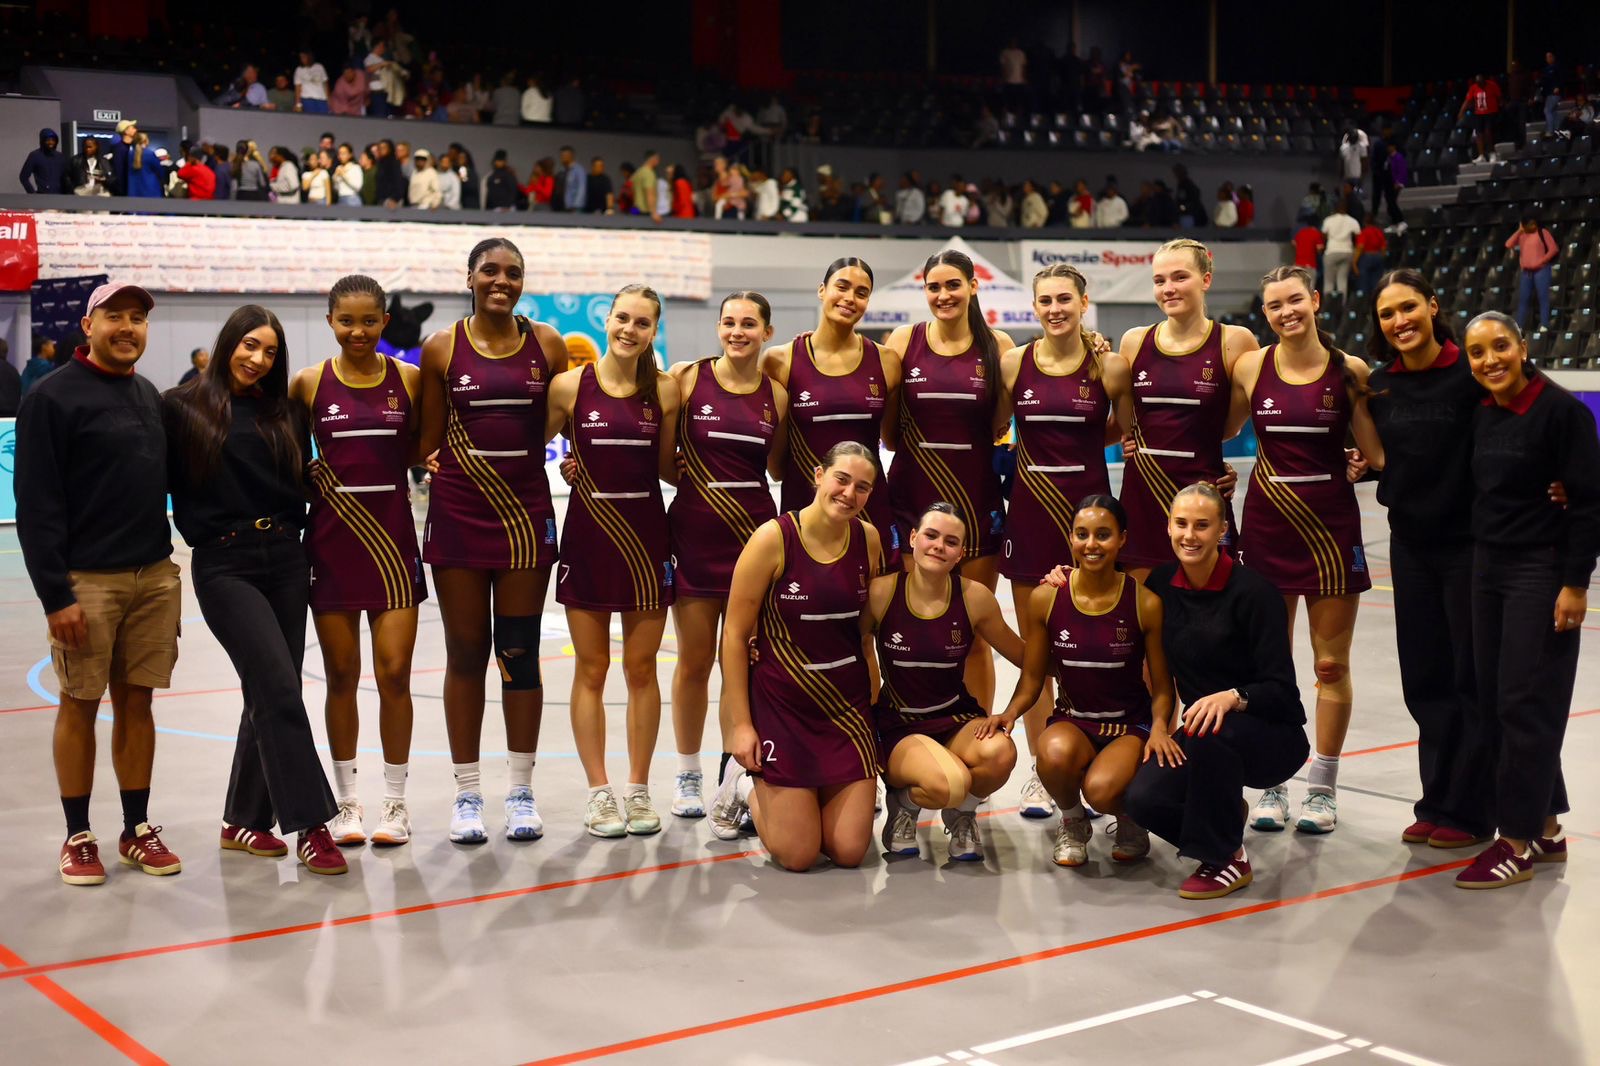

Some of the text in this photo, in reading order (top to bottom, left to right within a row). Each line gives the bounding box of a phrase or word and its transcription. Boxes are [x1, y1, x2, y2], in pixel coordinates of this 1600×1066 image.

[97, 111, 118, 120] EXIT
[452, 384, 480, 392] SUZUKI
[793, 400, 819, 408] SUZUKI
[321, 414, 349, 423] SUZUKI
[560, 563, 570, 584] 7
[780, 593, 809, 601] SUZUKI
[884, 641, 911, 652] SUZUKI
[1054, 640, 1077, 649] SUZUKI
[763, 739, 778, 762] 2
